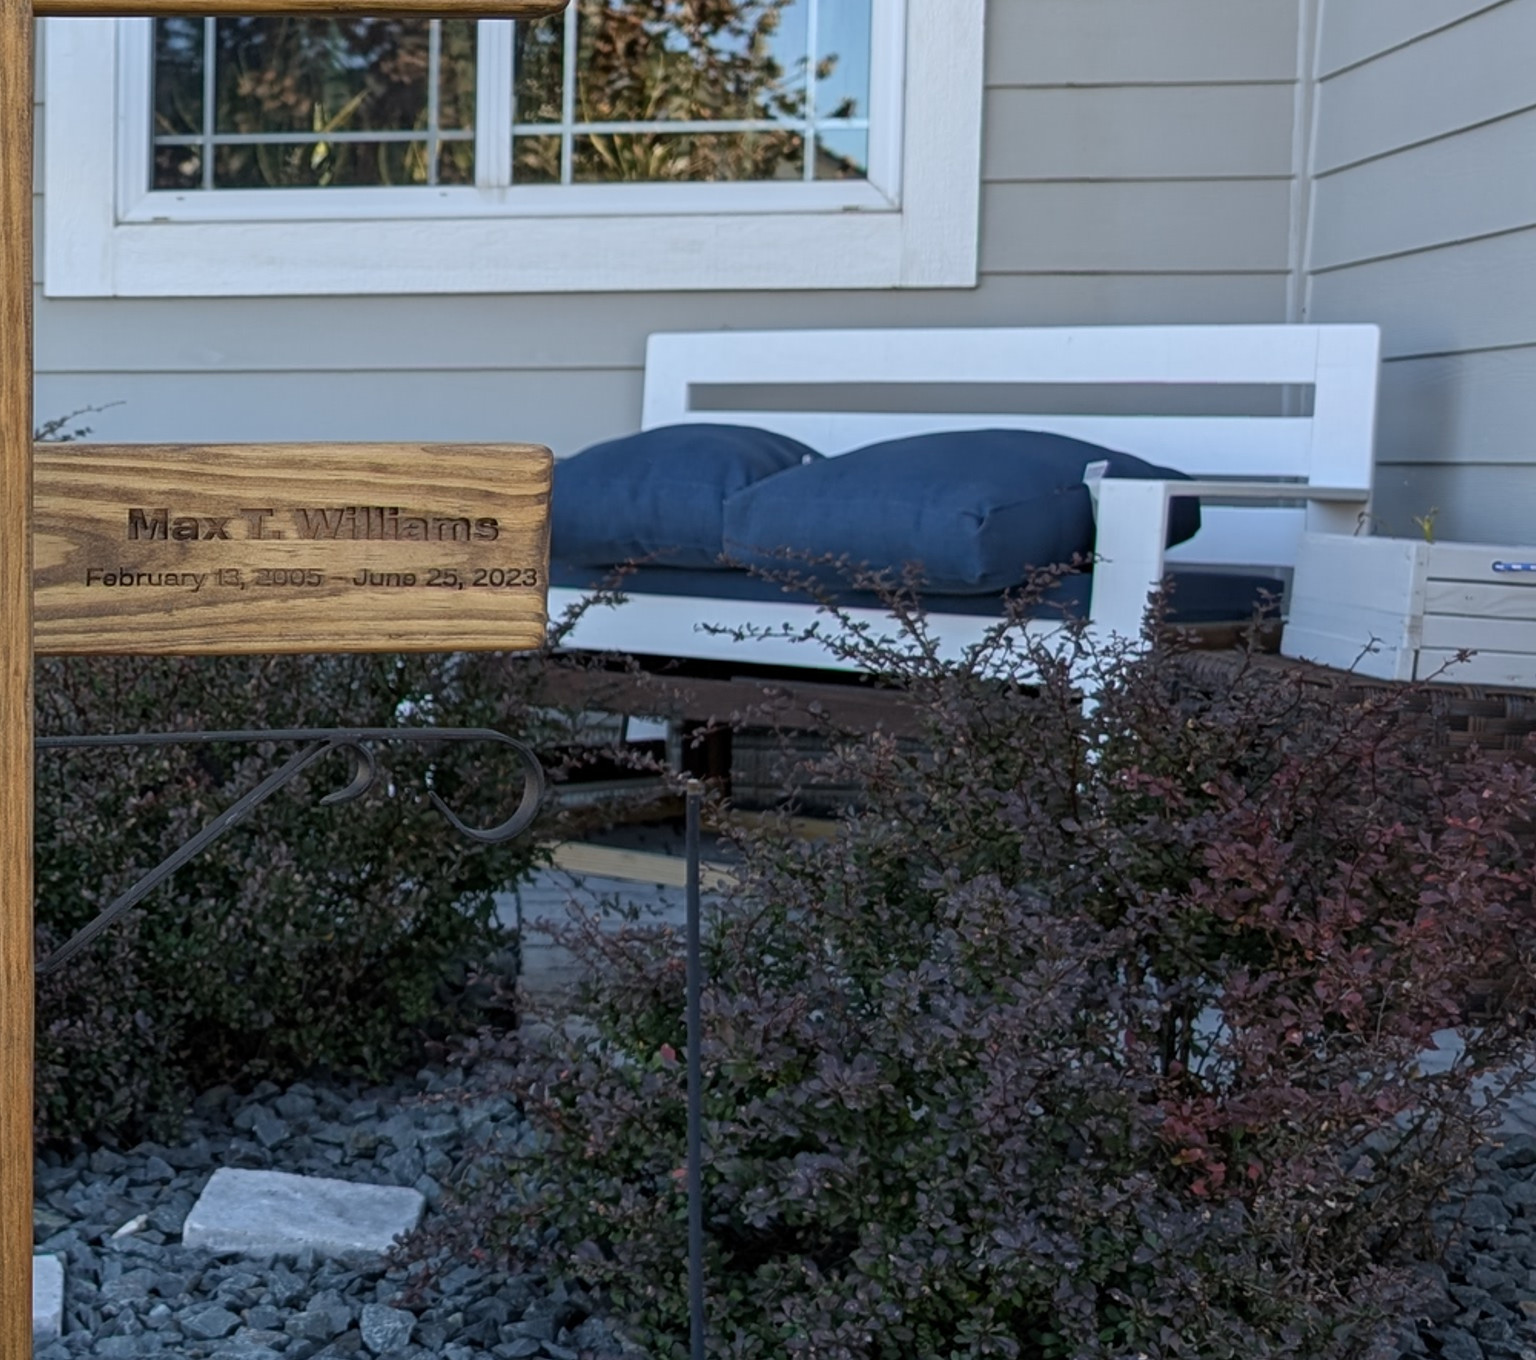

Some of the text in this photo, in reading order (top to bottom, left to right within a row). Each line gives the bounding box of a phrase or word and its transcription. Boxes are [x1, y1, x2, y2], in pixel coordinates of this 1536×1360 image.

[128, 506, 499, 541] Max T. Williams
[86, 567, 206, 592] February
[217, 568, 245, 590] 13,
[254, 568, 324, 587] 2005
[353, 568, 417, 587] June
[427, 568, 463, 590] 25,
[473, 568, 537, 587] 2023
